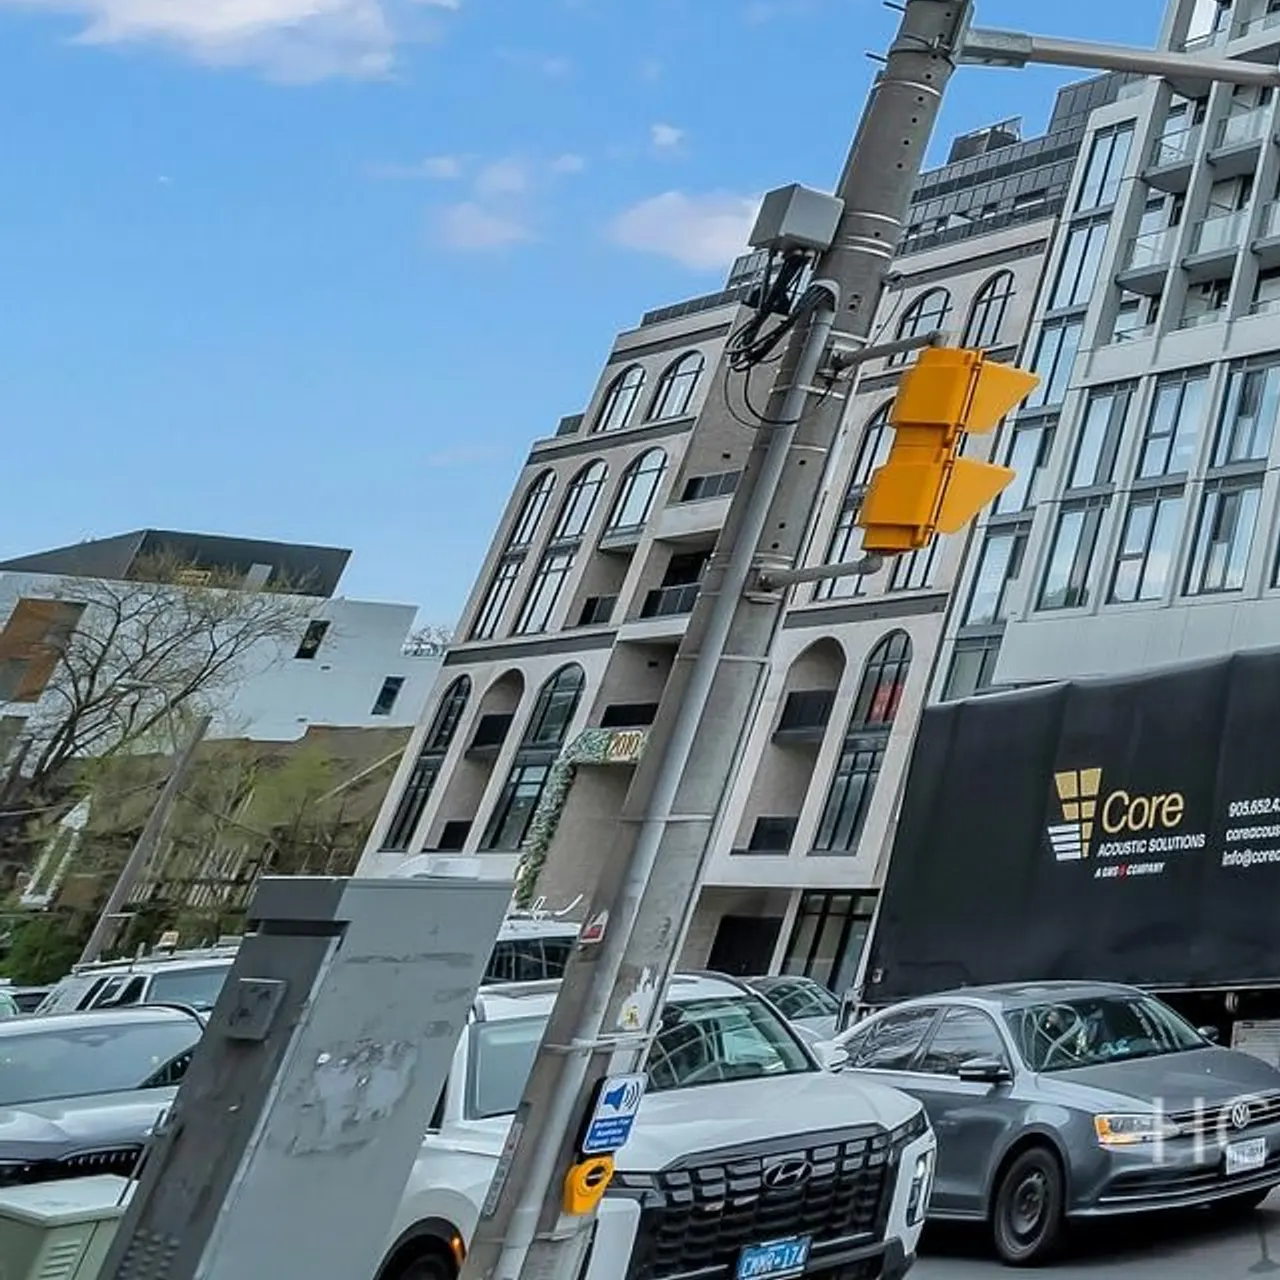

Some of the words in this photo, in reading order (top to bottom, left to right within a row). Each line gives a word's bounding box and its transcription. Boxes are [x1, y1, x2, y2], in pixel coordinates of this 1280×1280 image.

[1101, 789, 1185, 834] Core
[1096, 840, 1147, 858] ACOUSTIC
[1148, 833, 1206, 853] SOLUTIONS
